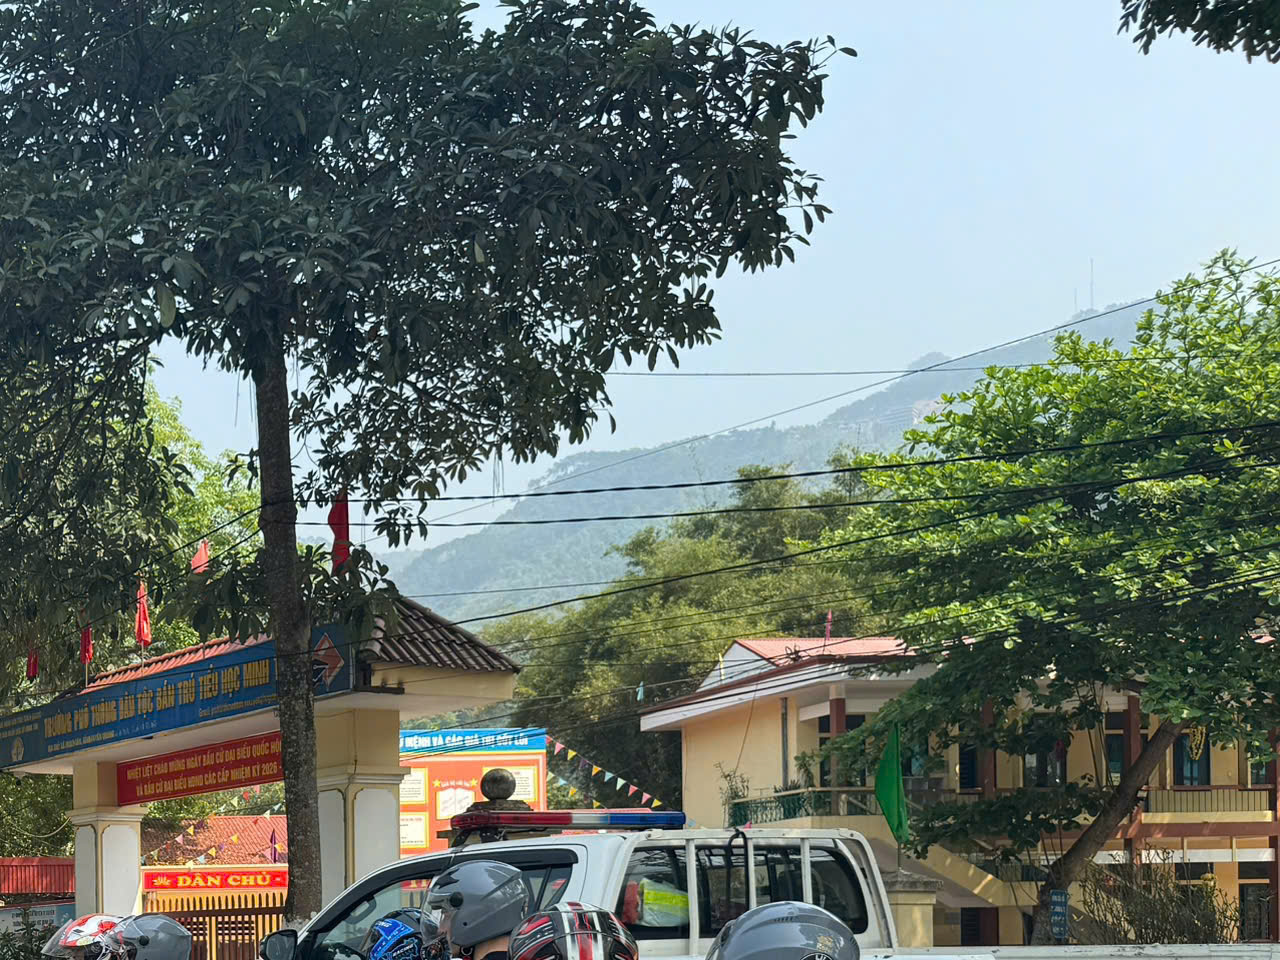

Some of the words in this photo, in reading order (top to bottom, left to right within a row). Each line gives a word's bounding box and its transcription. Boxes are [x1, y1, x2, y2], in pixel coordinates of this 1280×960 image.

[222, 666, 241, 699] HỌC
[244, 659, 270, 689] MINH
[252, 740, 270, 758] QUỐC
[262, 761, 278, 776] 2026
[177, 872, 221, 887] DÂN
[227, 871, 272, 886] CHỦ
